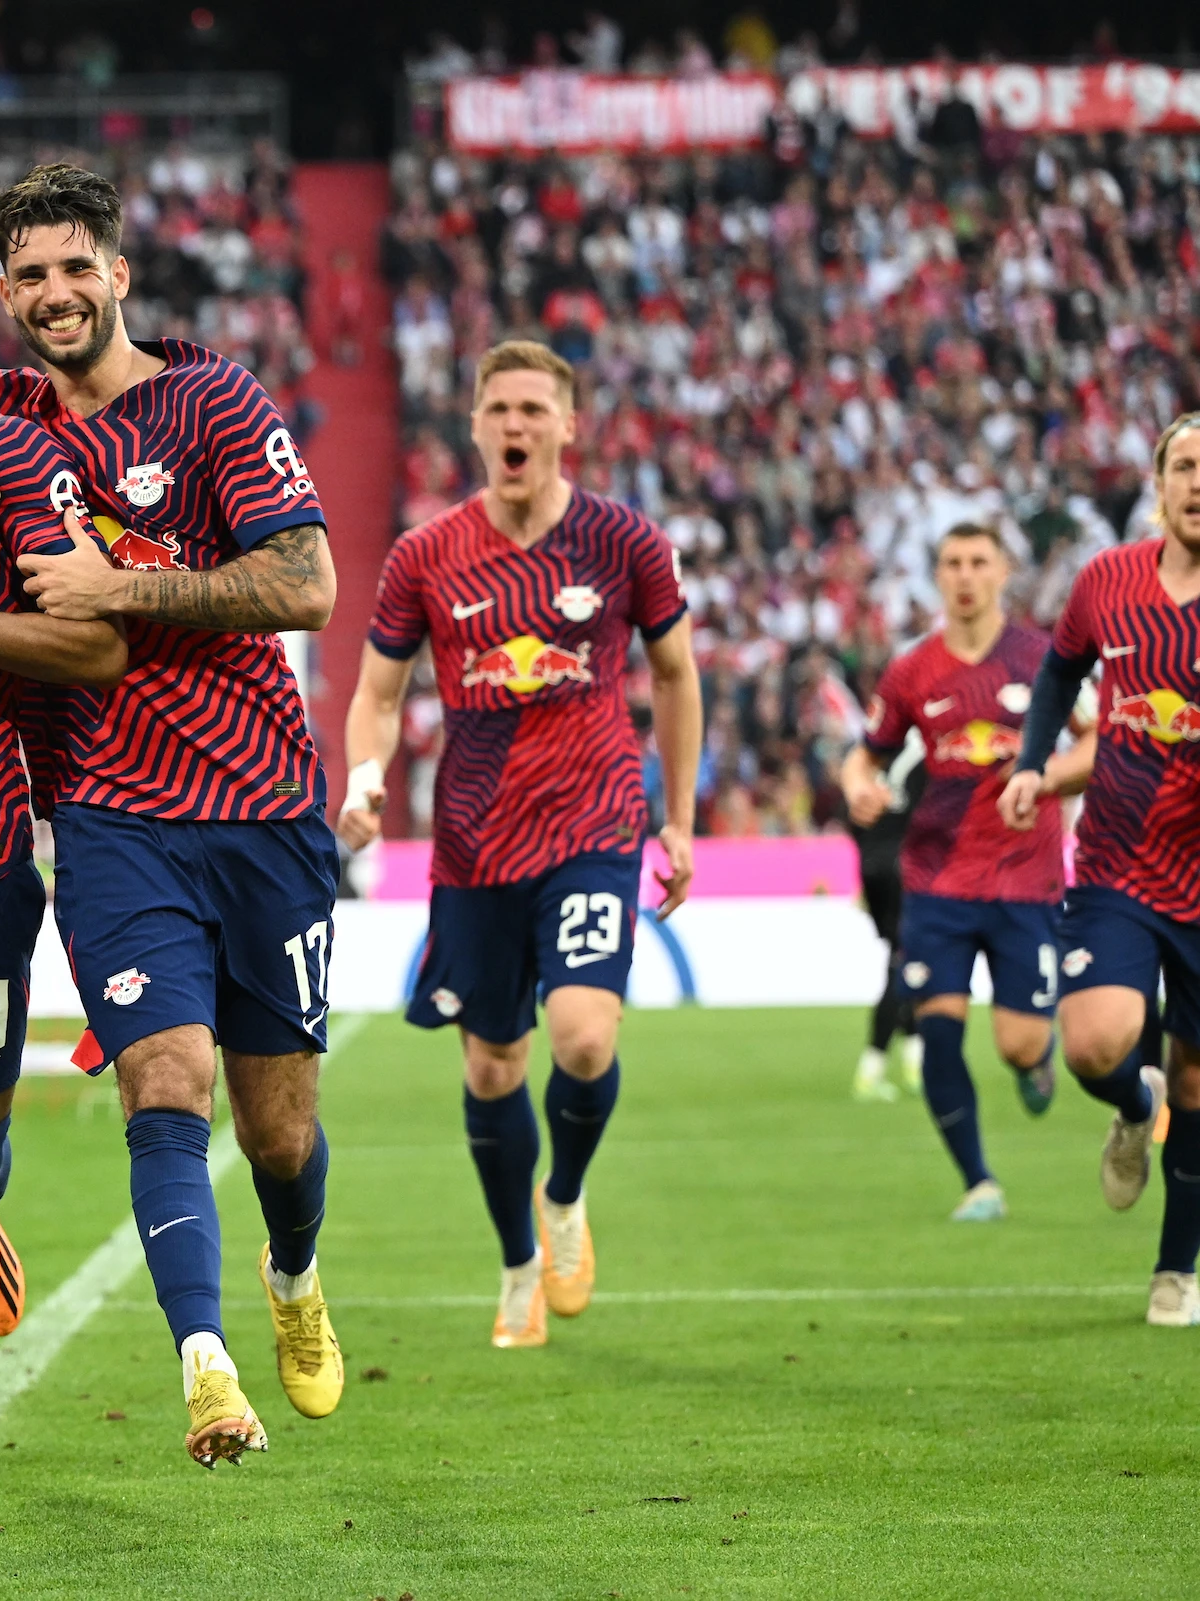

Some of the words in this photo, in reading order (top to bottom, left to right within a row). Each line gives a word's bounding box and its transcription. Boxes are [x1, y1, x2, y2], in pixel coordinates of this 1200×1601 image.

[139, 486, 160, 501] LEIPZIG
[557, 892, 622, 953] 23
[284, 920, 328, 1014] 17
